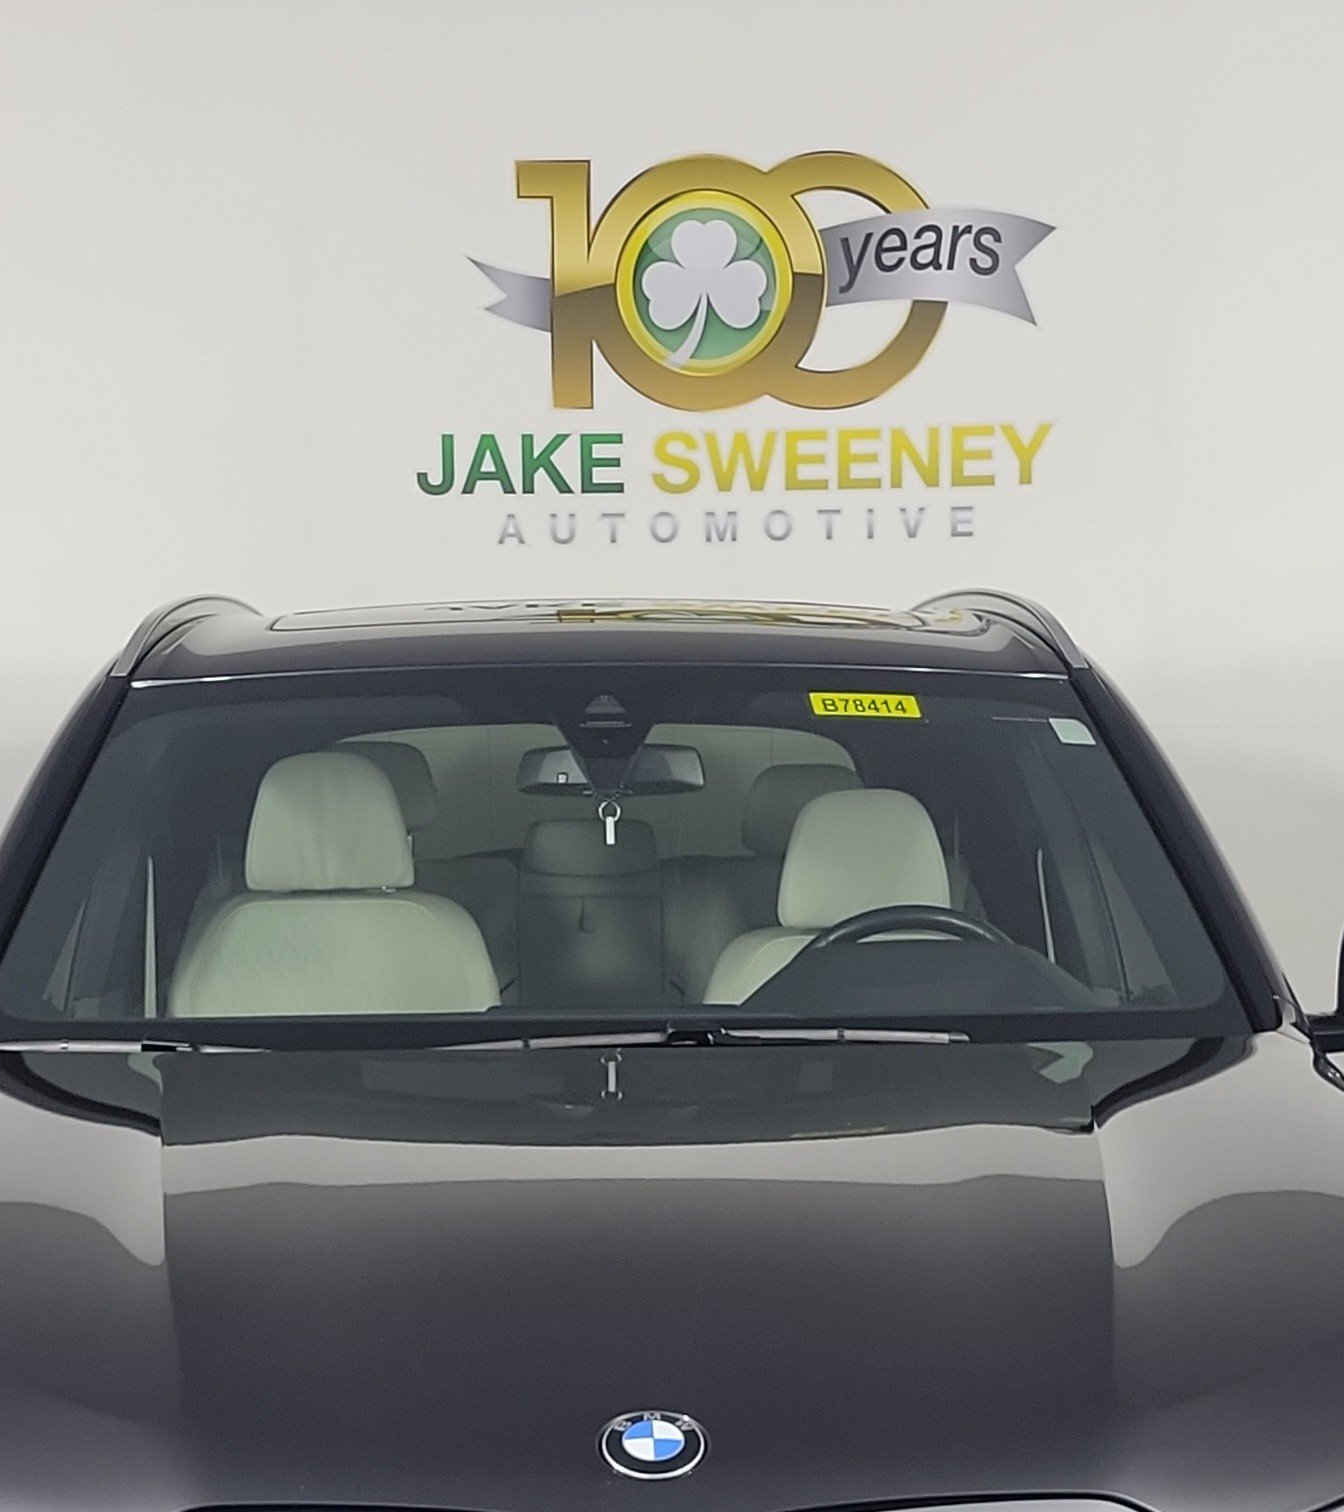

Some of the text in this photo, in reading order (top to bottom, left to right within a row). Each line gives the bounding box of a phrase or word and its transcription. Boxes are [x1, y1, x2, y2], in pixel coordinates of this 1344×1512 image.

[514, 151, 1003, 413] 100 years
[416, 423, 1053, 496] JAKE SWEENEY
[497, 506, 975, 546] AUTOMOTIVE
[821, 697, 907, 714] B78414
